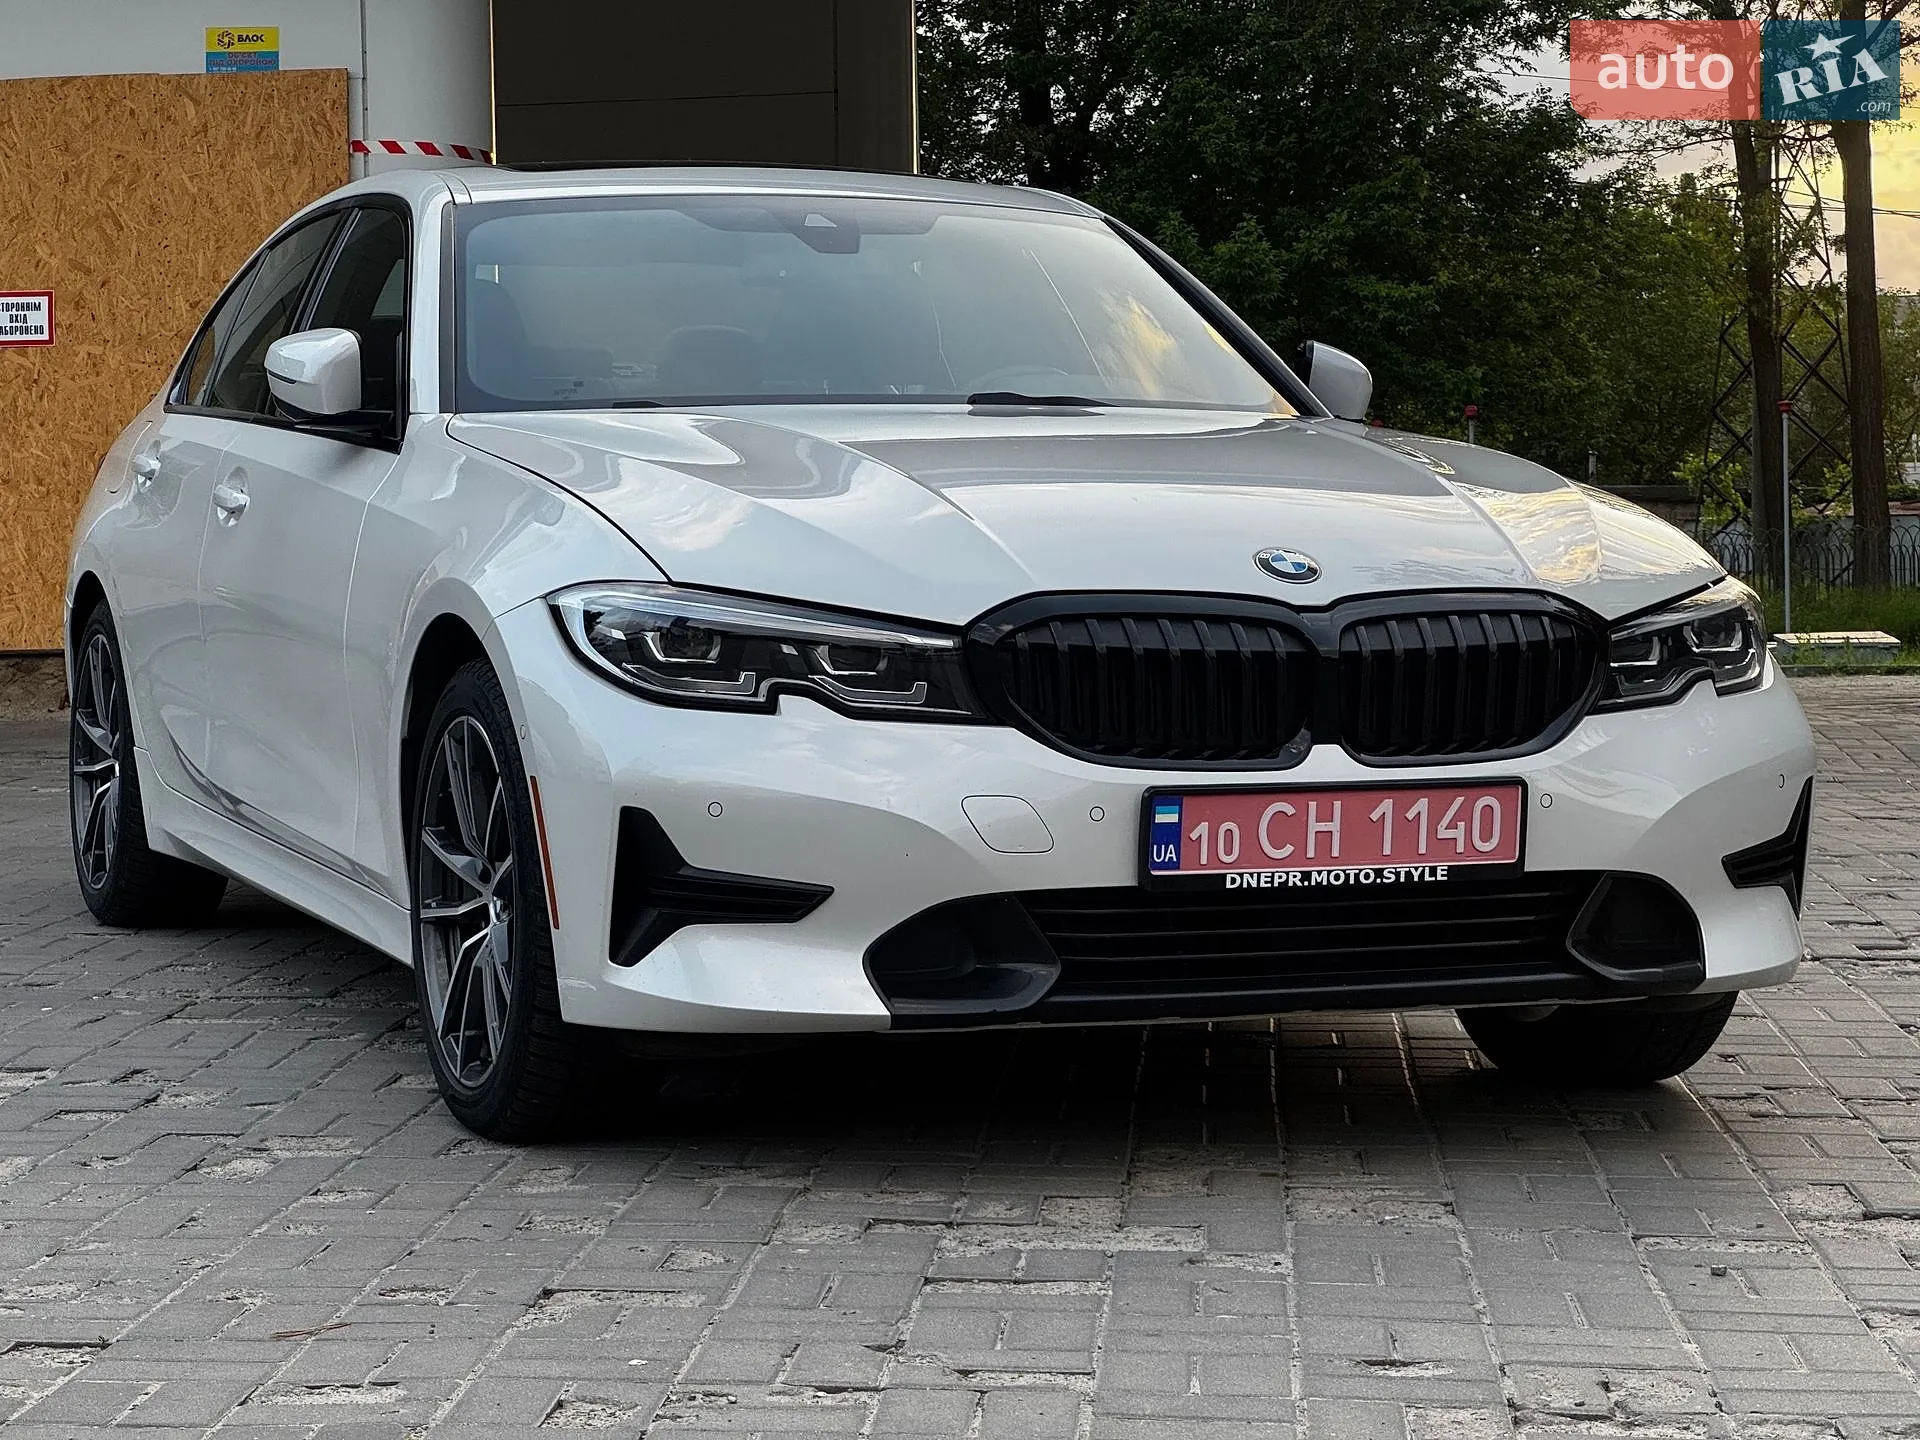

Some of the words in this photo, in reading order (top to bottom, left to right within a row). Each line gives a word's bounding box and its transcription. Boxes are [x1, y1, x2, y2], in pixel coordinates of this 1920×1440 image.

[0, 302, 42, 312] ТОРОННІМ
[9, 314, 28, 324] ВХІД
[1188, 821, 1241, 866] 10
[1257, 800, 1342, 860] CH
[1368, 795, 1502, 856] 1140
[1152, 843, 1177, 864] UA
[1225, 866, 1448, 889] DNEPR.MOTO.STYLE
